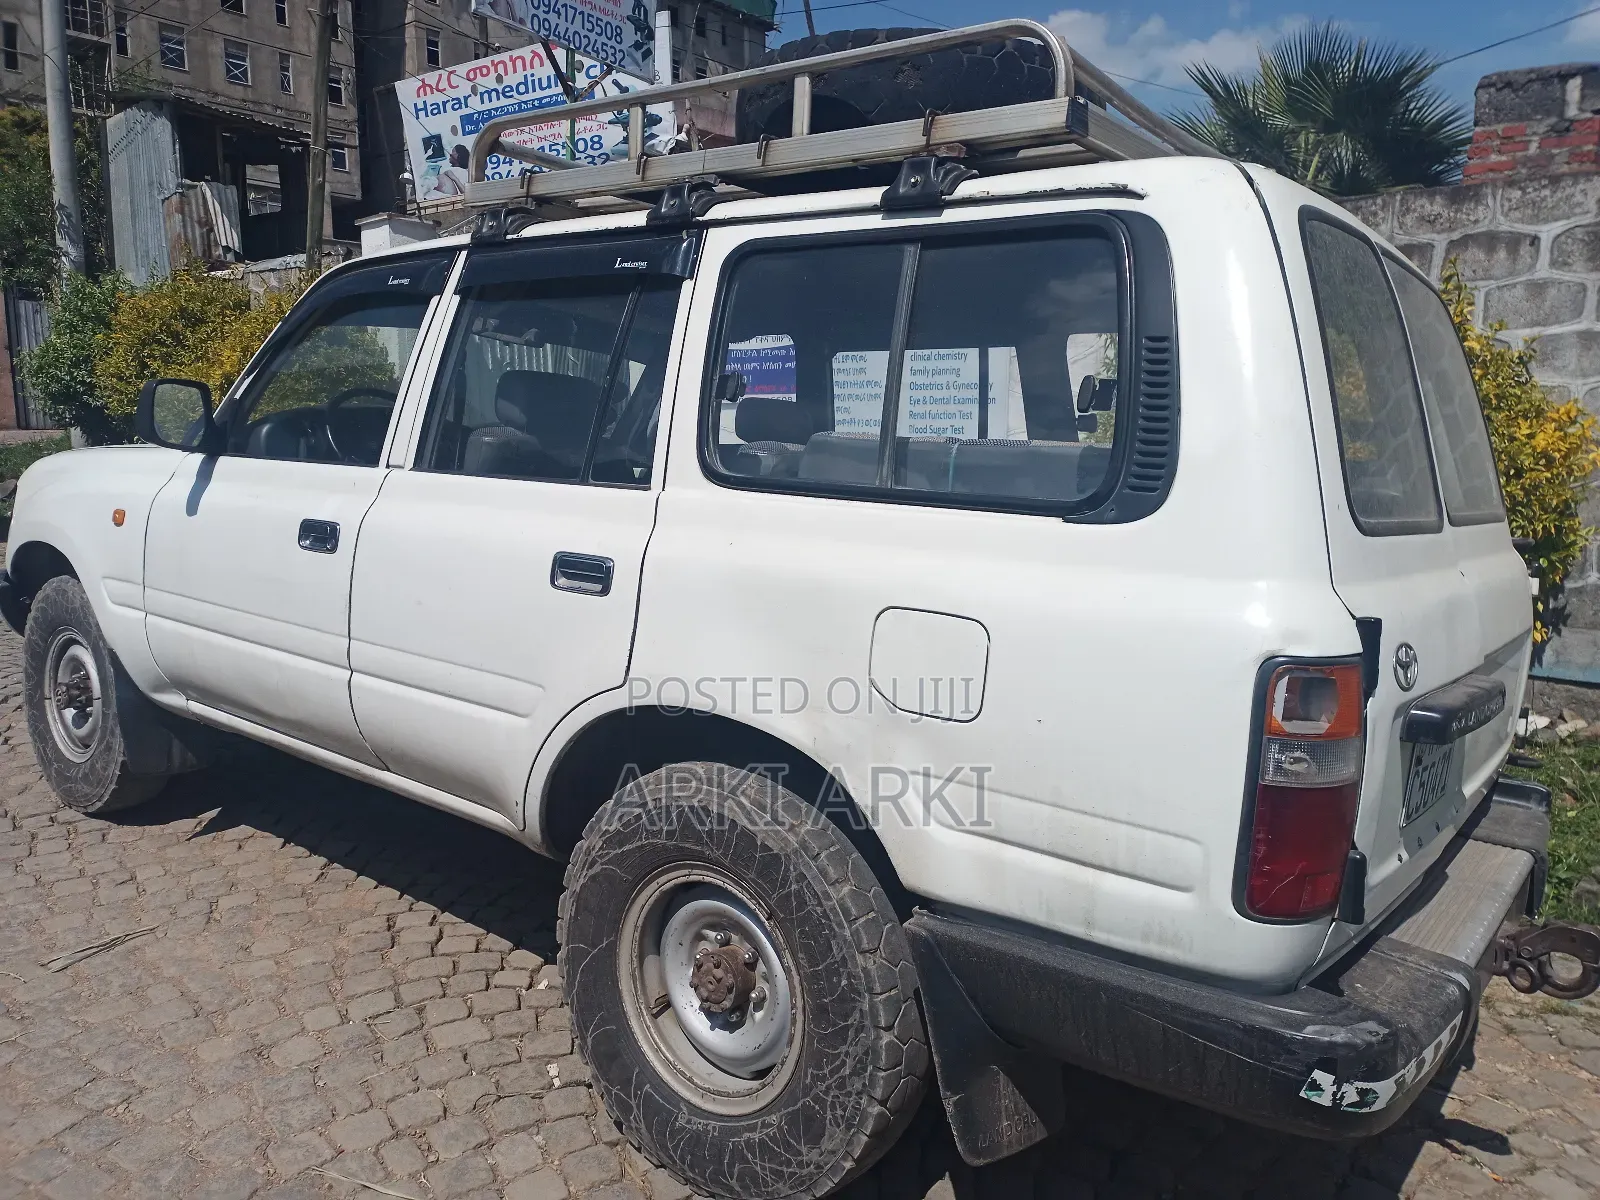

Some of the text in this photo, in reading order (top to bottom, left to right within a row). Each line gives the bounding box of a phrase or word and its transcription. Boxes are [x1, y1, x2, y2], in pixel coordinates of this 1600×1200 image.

[530, 0, 624, 45] 0941715508
[530, 13, 626, 69] 0944024532
[465, 49, 547, 82] መካከለ
[413, 94, 472, 120] Harar
[910, 350, 968, 363] clinical chemistry
[910, 365, 961, 378] family planning
[909, 380, 994, 392] Obstetrics & Gynecoy
[909, 395, 996, 407] Eye & Dental Examinon
[908, 409, 973, 420] Renal function Test
[908, 424, 965, 436] Blood Sugar Test
